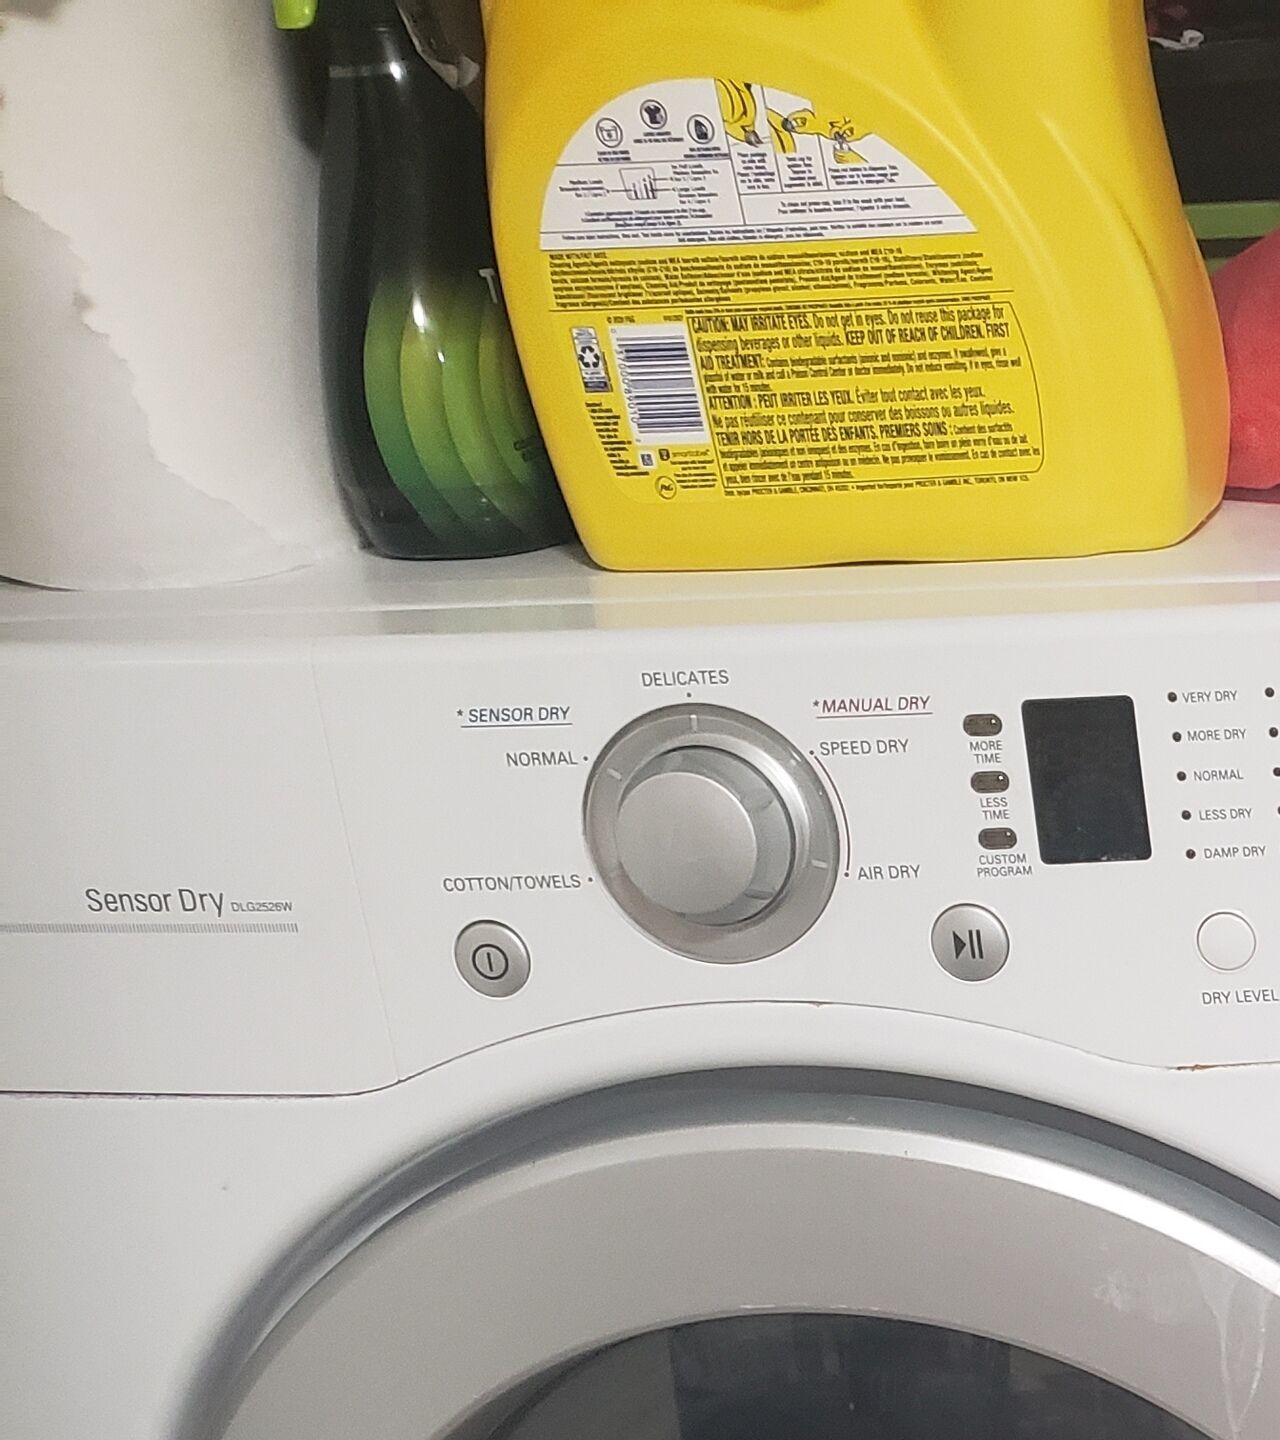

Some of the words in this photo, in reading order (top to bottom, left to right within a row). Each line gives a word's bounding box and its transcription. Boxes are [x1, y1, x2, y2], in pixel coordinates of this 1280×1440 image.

[730, 316, 749, 332] MAY
[845, 330, 865, 346] KEEP
[986, 321, 1009, 339] FIRST
[641, 669, 730, 688] DELICATES
[1182, 691, 1211, 703] VERY
[1215, 690, 1238, 702] DRY
[821, 697, 893, 714] MANUAL
[898, 695, 931, 711] DRY
[468, 706, 534, 723] SENSOR
[538, 705, 571, 722] DRY
[1187, 730, 1221, 742] MORE
[1224, 728, 1247, 741] DRY
[820, 740, 872, 757] SPEED
[876, 738, 909, 754] DRY
[969, 740, 1003, 753] MORE
[506, 750, 579, 768] NORMAL
[974, 753, 1002, 765] TIME
[1193, 769, 1245, 782] NORMAL
[980, 797, 1008, 809] LESS
[982, 809, 1010, 821] TIME
[1199, 808, 1228, 821] LESS
[1230, 807, 1253, 820] DRY
[978, 853, 1027, 866] CUSTOM
[1204, 847, 1240, 860] DAMP
[1243, 845, 1267, 858] DRY
[858, 865, 884, 881] AIR
[889, 864, 921, 880] DRY
[977, 865, 1033, 878] PROGRAM
[442, 873, 582, 893] COTTON/TOWELS
[85, 888, 172, 913] Sensor
[178, 888, 225, 918] Dry
[231, 901, 294, 913] DLG2526W
[1202, 990, 1231, 1005] DRY
[1235, 989, 1280, 1003] LEVEL
